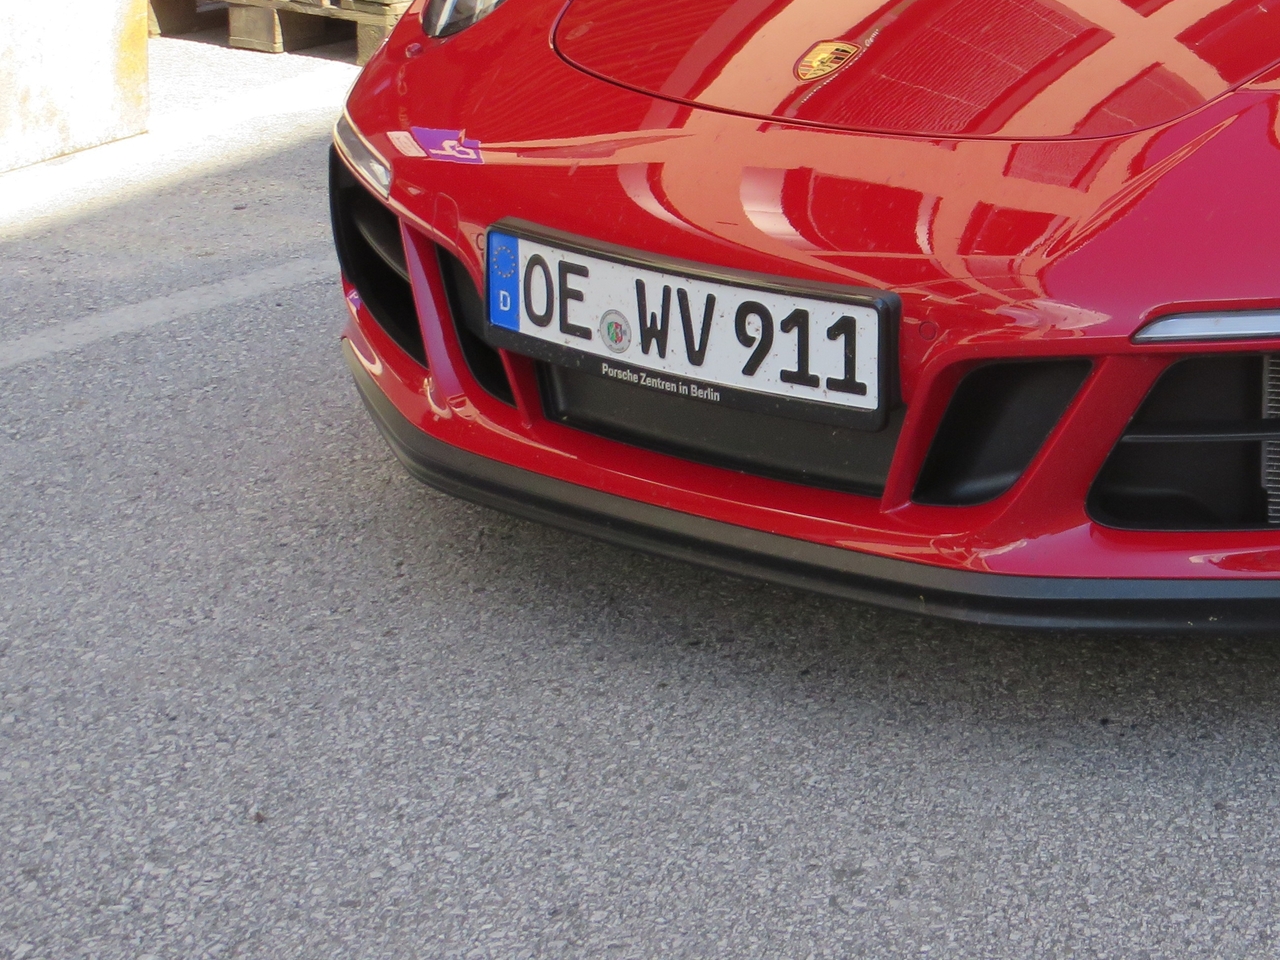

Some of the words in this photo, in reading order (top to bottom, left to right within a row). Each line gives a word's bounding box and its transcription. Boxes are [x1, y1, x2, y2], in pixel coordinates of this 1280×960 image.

[500, 290, 511, 312] D
[523, 253, 592, 340] OE
[635, 278, 716, 366] WV
[735, 300, 867, 396] 911
[602, 363, 638, 383] Porsche
[640, 373, 677, 393] Zentren
[679, 382, 688, 395] in
[691, 384, 720, 402] Berlin
